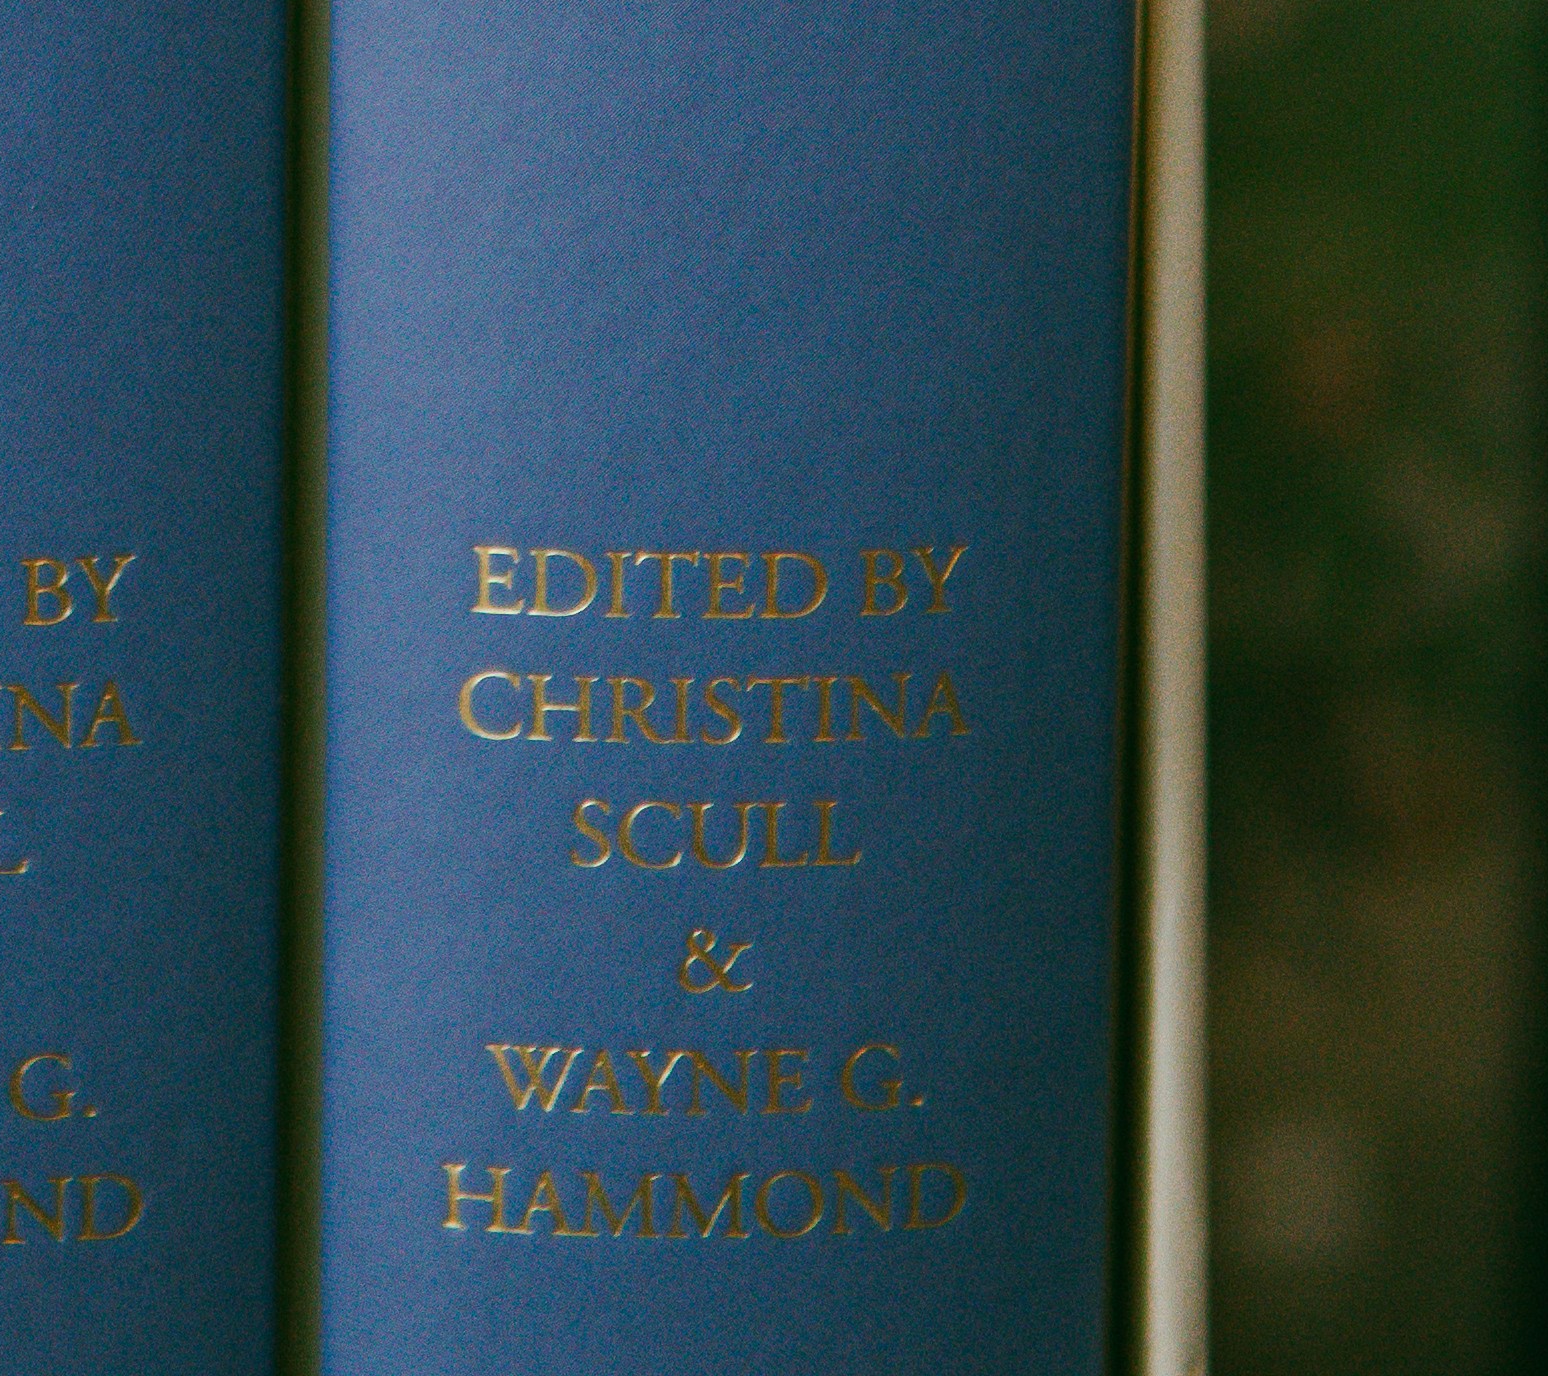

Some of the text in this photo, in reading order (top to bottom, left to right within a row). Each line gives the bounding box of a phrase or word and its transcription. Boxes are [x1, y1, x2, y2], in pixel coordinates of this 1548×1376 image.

[20, 552, 135, 627] BY
[471, 540, 969, 620] EDITED BY
[456, 666, 972, 746] CHRISTINA
[569, 797, 864, 871] SCULL
[677, 926, 753, 994] &
[8, 1051, 99, 1123] G.
[486, 1040, 925, 1117] WAYNE G.
[441, 1159, 969, 1240] HAMMOND
